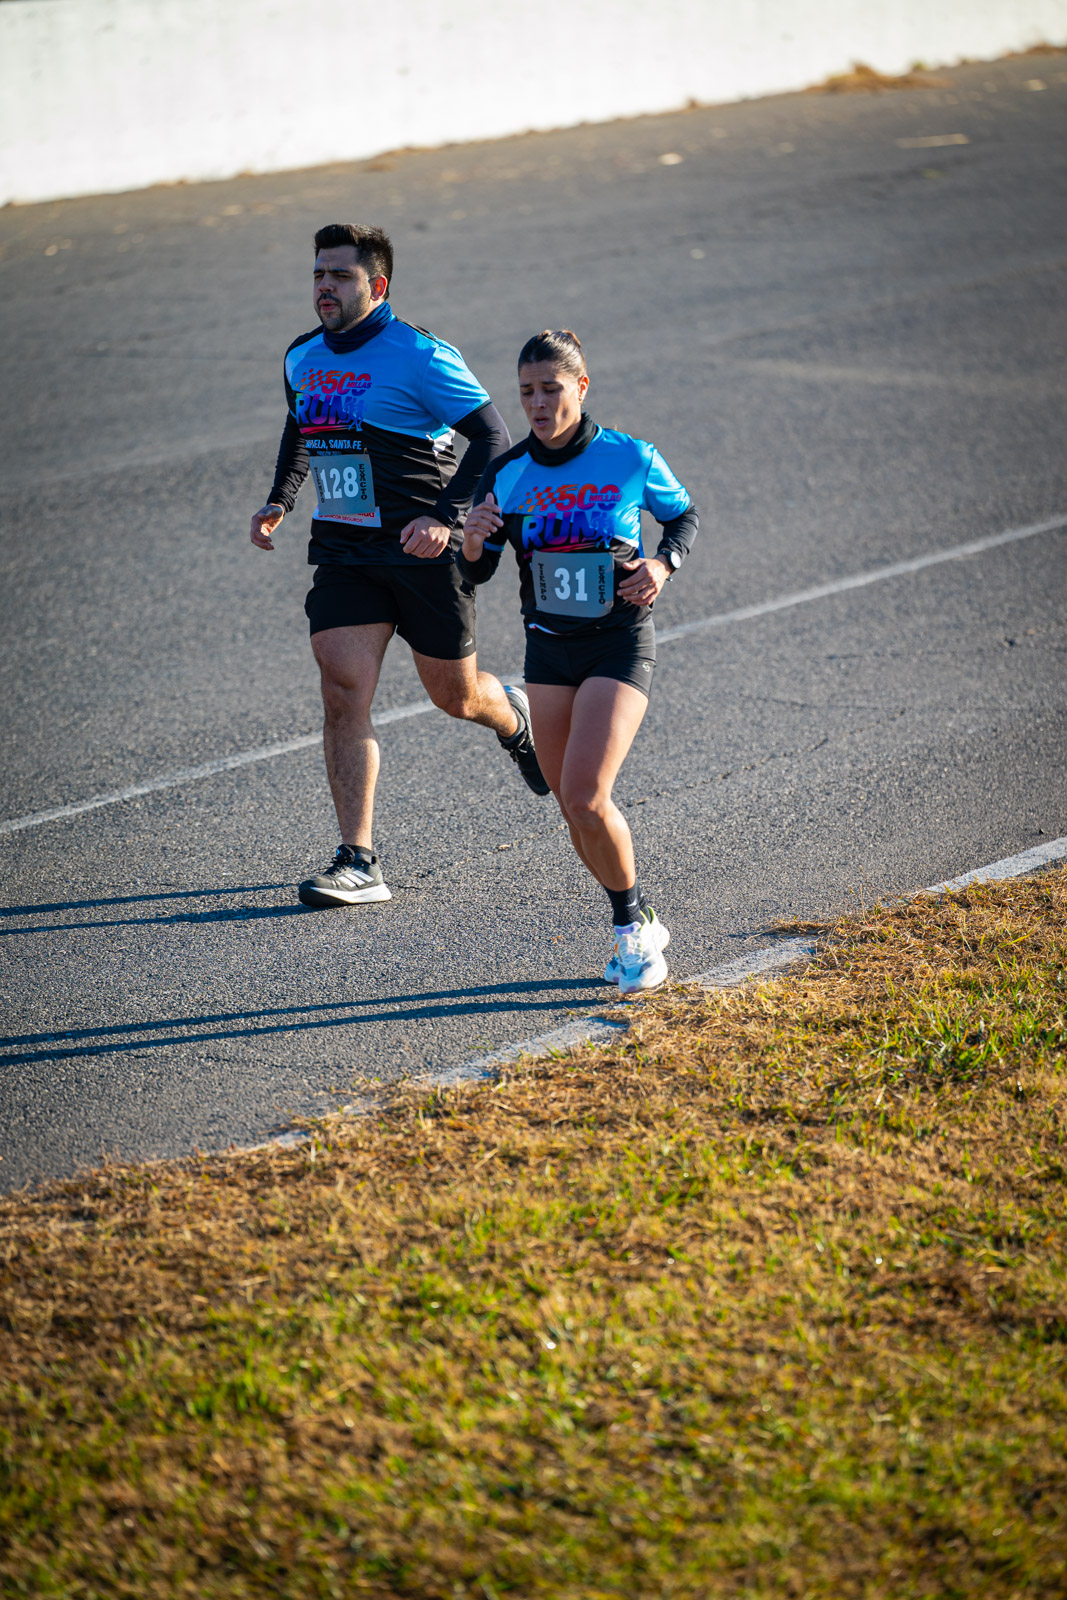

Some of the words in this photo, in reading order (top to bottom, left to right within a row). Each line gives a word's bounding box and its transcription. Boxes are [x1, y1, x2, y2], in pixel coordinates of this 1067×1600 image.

[321, 370, 371, 396] 500
[296, 393, 352, 425] RUN
[328, 439, 351, 449] SANTA
[352, 440, 362, 450] FE
[320, 466, 359, 499] 128
[358, 463, 368, 500] EXACTO
[555, 484, 620, 511] 500
[589, 494, 621, 502] MILLAS
[522, 511, 602, 550] RUN
[537, 562, 547, 601] TIEMPO
[554, 567, 588, 601] 31
[598, 565, 606, 604] EXACTO
